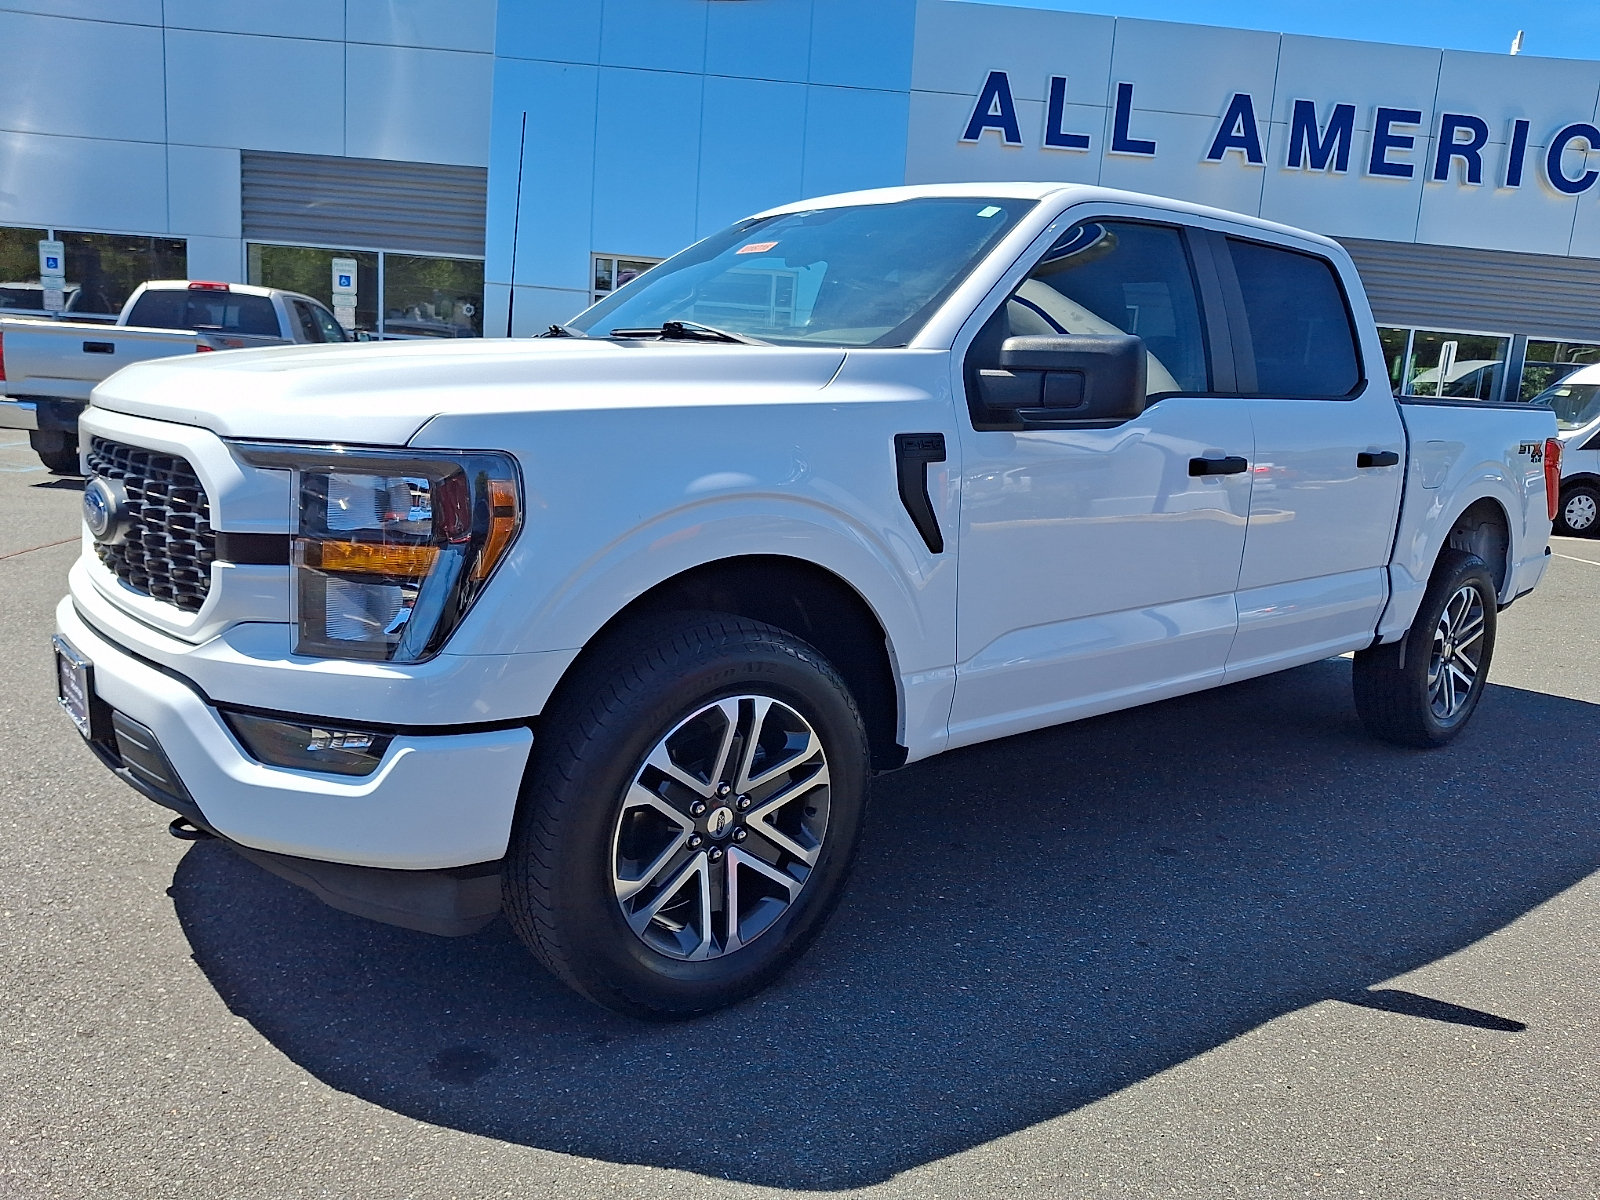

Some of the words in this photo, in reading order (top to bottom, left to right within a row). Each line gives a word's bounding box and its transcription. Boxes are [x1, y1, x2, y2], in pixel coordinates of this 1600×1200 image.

[961, 70, 1156, 157] ALL
[1204, 93, 1600, 196] AMERIC
[1518, 440, 1543, 457] STX
